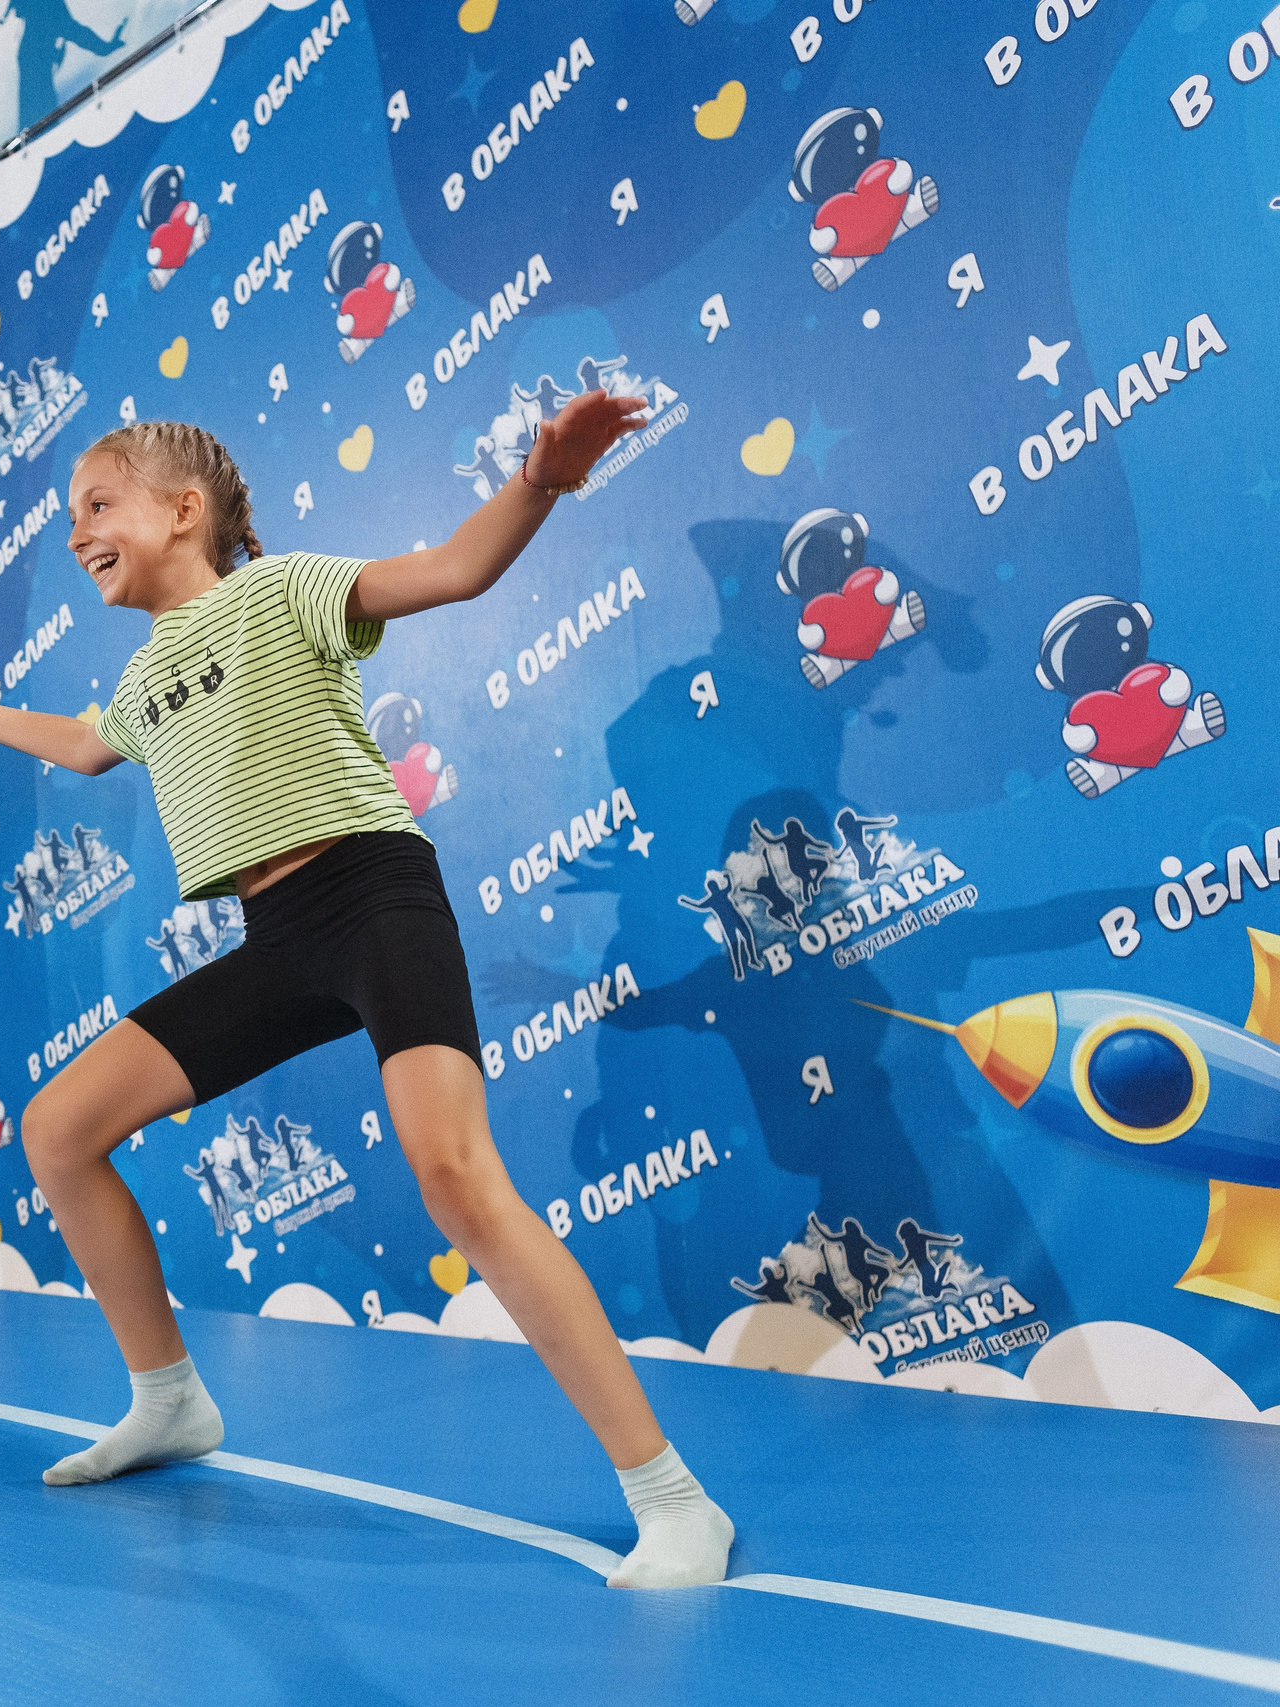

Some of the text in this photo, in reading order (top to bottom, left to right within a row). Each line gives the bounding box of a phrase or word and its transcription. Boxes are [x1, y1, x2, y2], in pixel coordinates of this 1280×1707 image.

[790, 16, 822, 62] В
[984, 35, 1022, 85] В
[231, 0, 350, 153] В ОБЛАКА
[387, 90, 410, 132] Я
[1169, 74, 1213, 128] В
[442, 37, 595, 211] В ОБЛАКА
[35, 174, 110, 277] ОБЛАКА
[610, 178, 639, 226] Я
[211, 188, 328, 330] В ОБЛАКА
[947, 252, 985, 308] Я
[92, 293, 109, 327] Я
[404, 254, 552, 411] В ОБЛАКА
[700, 293, 730, 343] Я
[268, 363, 289, 402] Я
[969, 313, 1227, 515] В ОБЛАКА
[293, 480, 315, 521] Я
[4, 603, 74, 689] ОБЛАКА
[485, 566, 646, 710] В ОБЛАКА
[690, 671, 719, 718] Я
[55, 853, 131, 921] ОБЛАКА
[478, 787, 637, 915] В ОБЛАКА
[763, 853, 966, 977] В ОБЛАКА
[832, 883, 979, 970] батутный центр
[1099, 906, 1141, 957] В
[28, 995, 119, 1082] В ОБЛАКА
[481, 963, 639, 1080] В ОБЛАКА
[802, 1057, 833, 1103] Я
[361, 1110, 382, 1149] Я
[233, 1209, 253, 1236] В
[254, 1158, 349, 1223] ОБЛАКА
[546, 1130, 718, 1239] В ОБЛАКА
[859, 1283, 1036, 1365] ОБЛАКА
[983, 1319, 1051, 1356] центр
